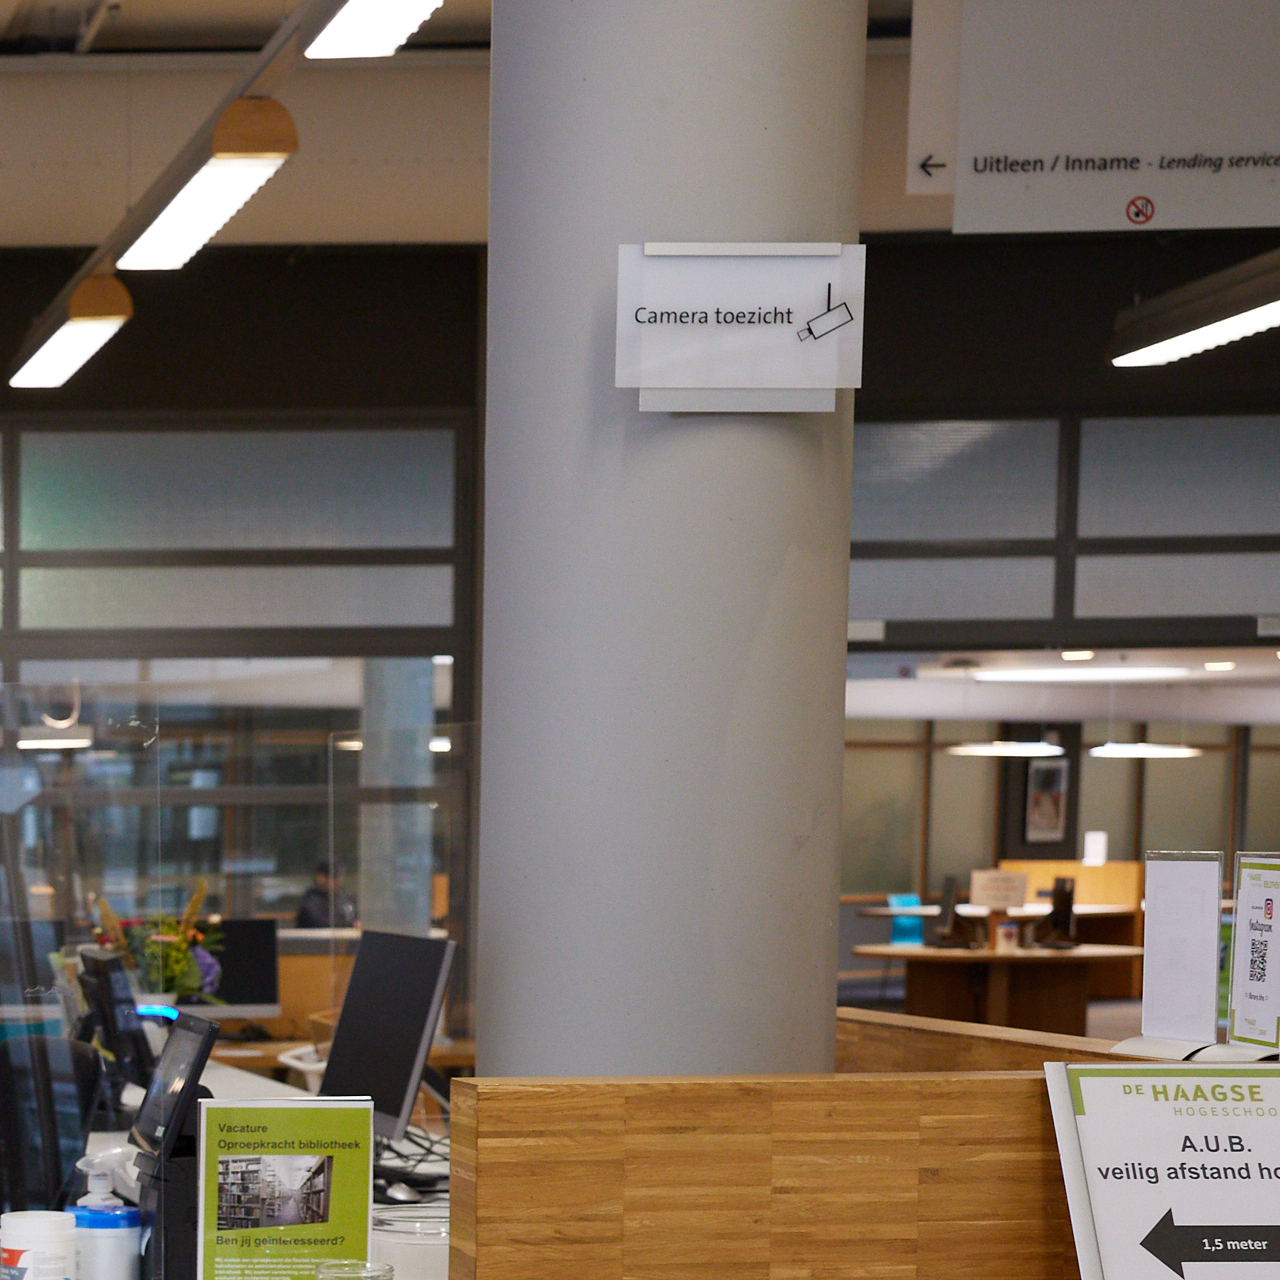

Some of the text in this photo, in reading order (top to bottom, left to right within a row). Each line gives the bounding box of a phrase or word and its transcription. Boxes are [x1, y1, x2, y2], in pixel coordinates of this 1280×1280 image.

[973, 155, 1044, 173] Uitleen
[1050, 154, 1060, 173] /
[1065, 154, 1140, 171] Inname
[1159, 153, 1223, 173] Lending
[634, 306, 794, 325] Camera toezicht
[1122, 1084, 1264, 1102] DE HAAGSE
[218, 1123, 268, 1133] Vacature
[218, 1139, 361, 1151] Oproepkracht bibliotheek
[1181, 1135, 1252, 1153] A.U.B.
[1097, 1162, 1159, 1184] veilig
[1166, 1162, 1251, 1180] afstand
[216, 1235, 346, 1248] Ben jij geïnteresseerd?
[1202, 1238, 1268, 1252] 1,5 meter
